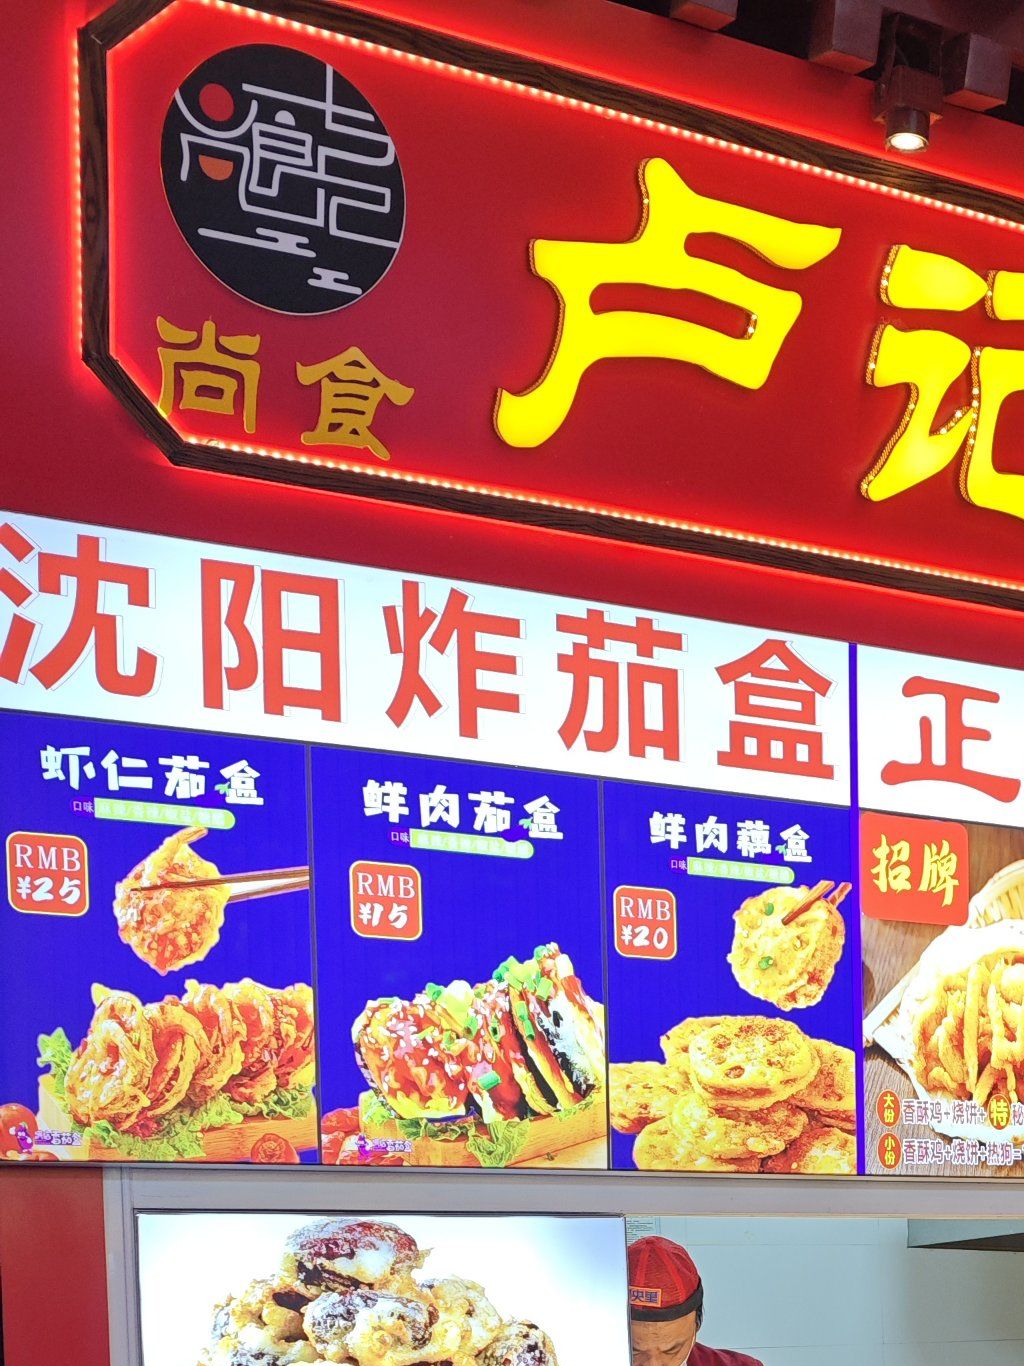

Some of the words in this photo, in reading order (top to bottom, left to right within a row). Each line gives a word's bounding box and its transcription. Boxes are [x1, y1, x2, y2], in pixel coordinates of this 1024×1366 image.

[156, 316, 414, 461] 尚食
[0, 522, 837, 781] 沈阳炸茄盒
[40, 745, 264, 805] 虾仁茄盒
[362, 779, 563, 839] 鲜肉茄盒
[649, 811, 812, 863] 鲜肉藕盒
[14, 843, 81, 872] RMB
[870, 833, 959, 907] 招牌
[16, 876, 81, 904] ¥25
[357, 872, 415, 898] RMB
[620, 896, 671, 921] RMB
[621, 924, 668, 950] ¥20
[882, 1094, 895, 1123] 大份
[884, 1137, 896, 1165] 小份
[629, 1288, 659, 1304] 央里
